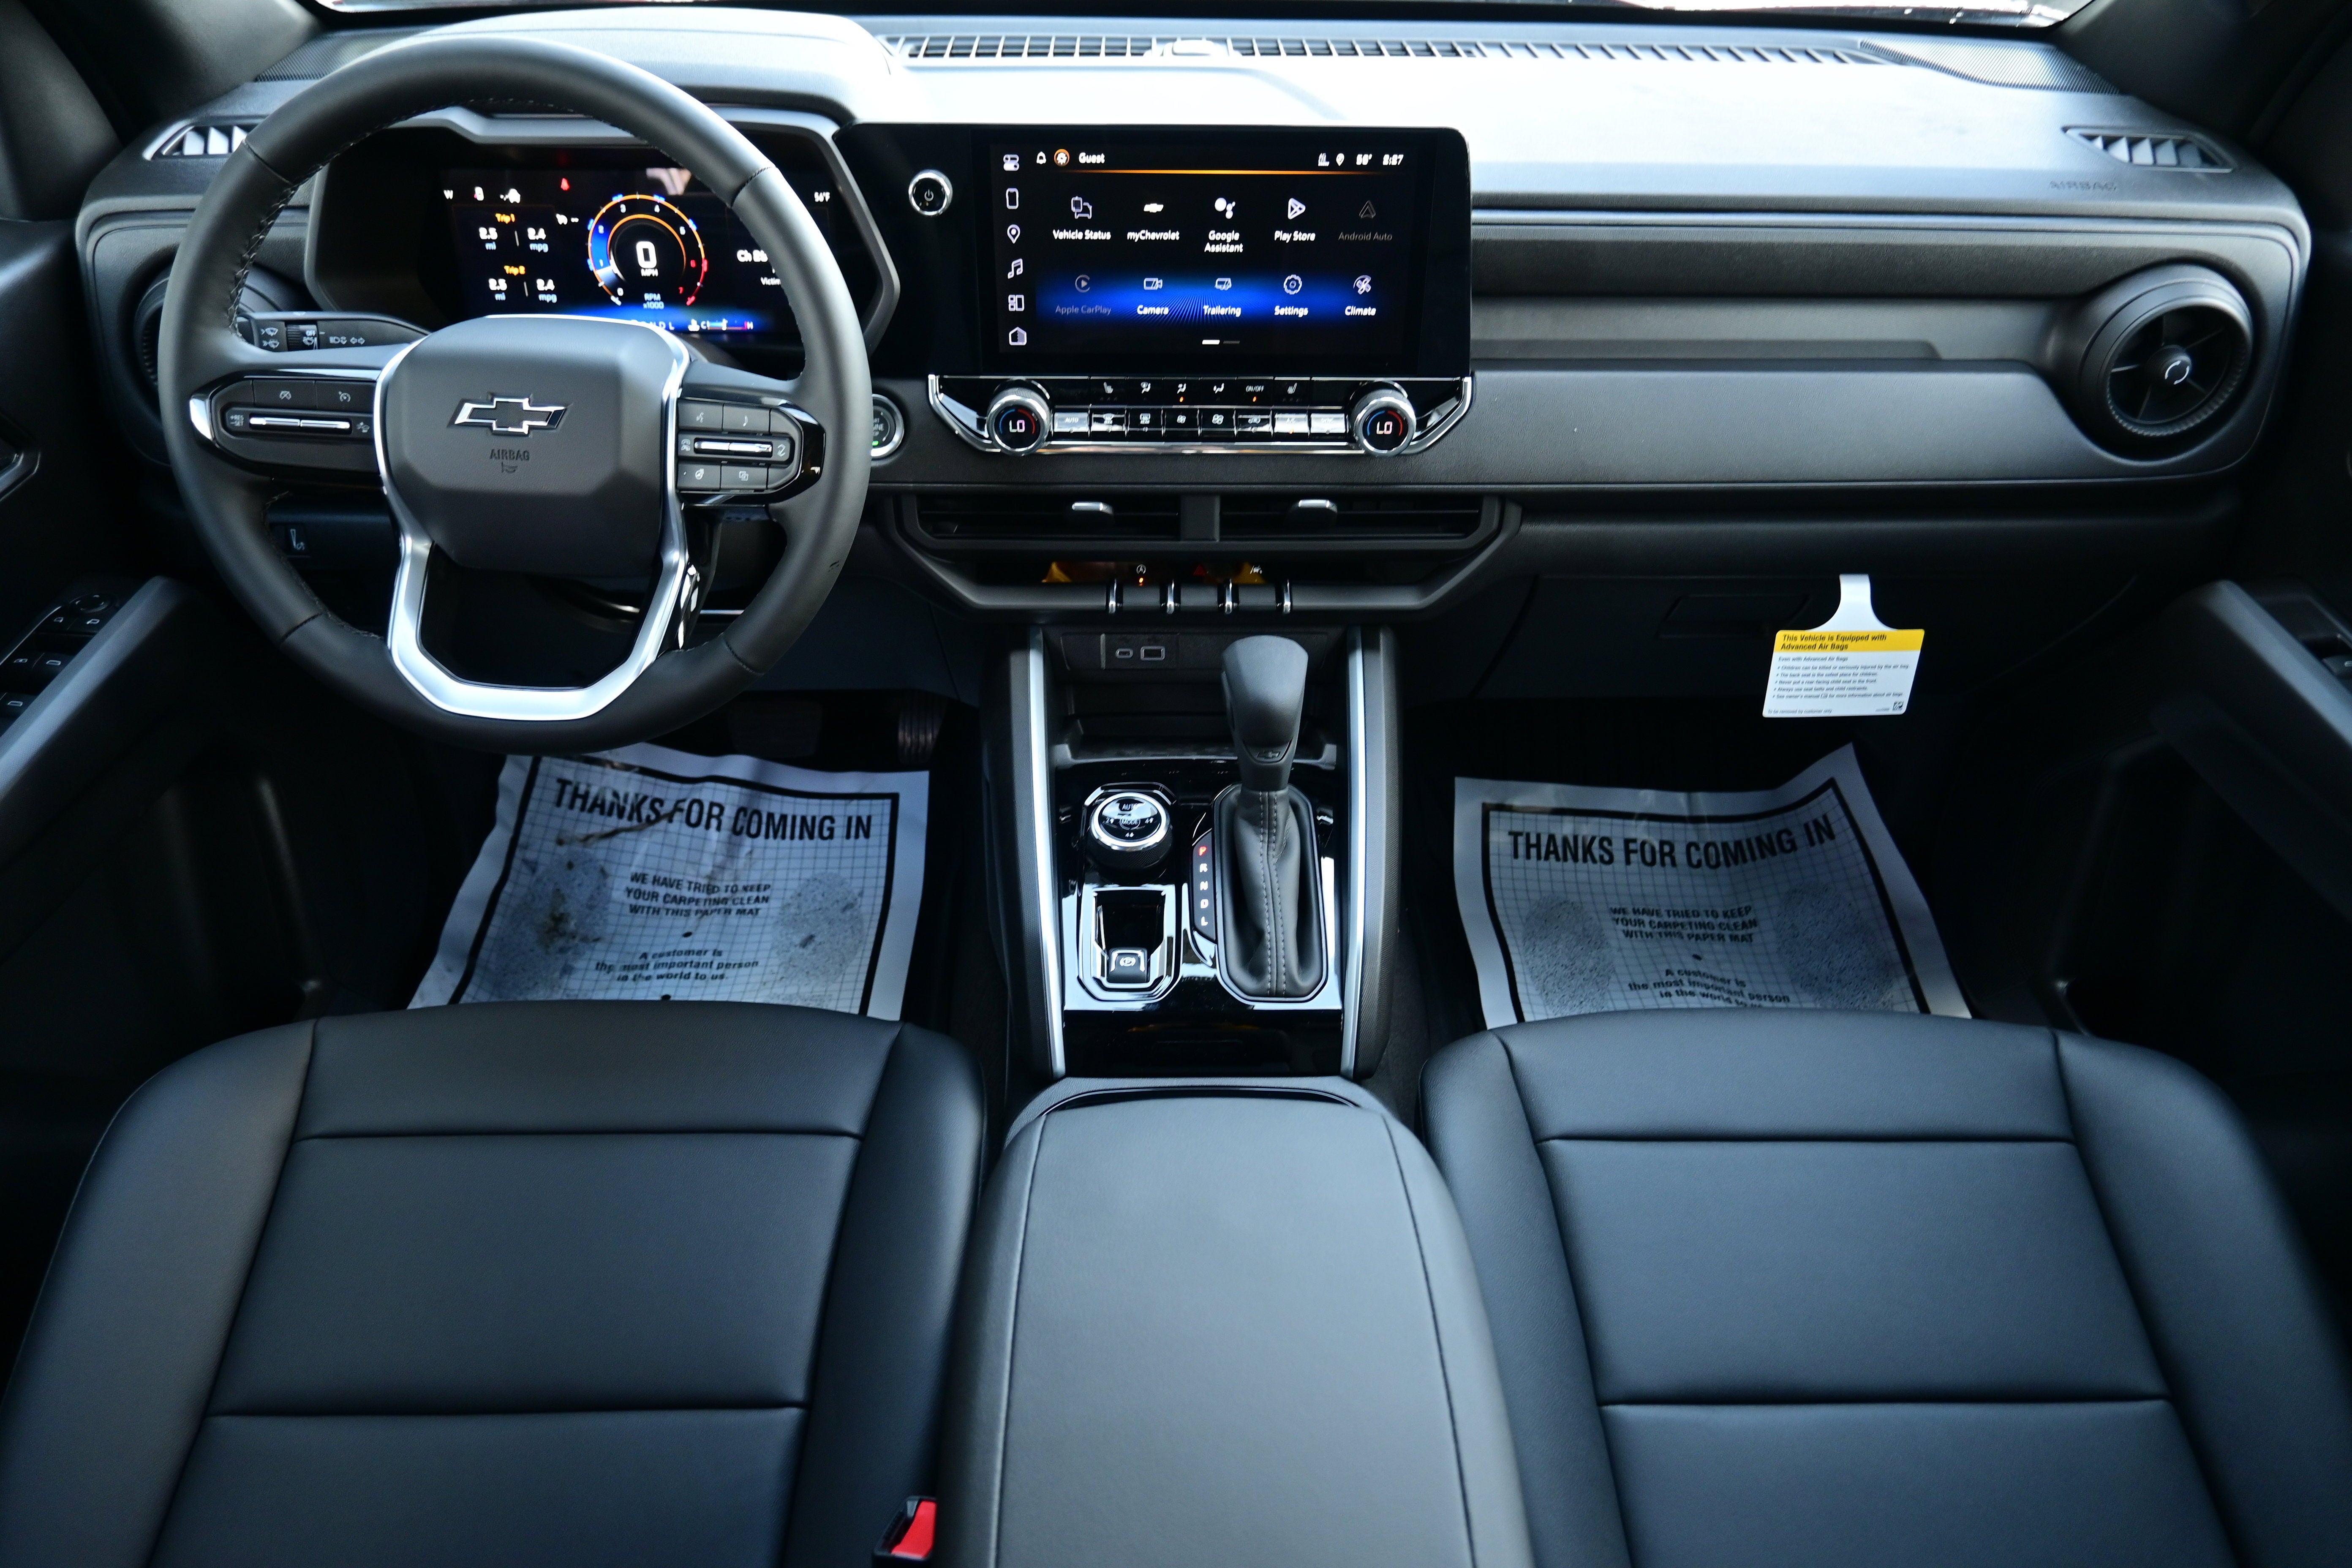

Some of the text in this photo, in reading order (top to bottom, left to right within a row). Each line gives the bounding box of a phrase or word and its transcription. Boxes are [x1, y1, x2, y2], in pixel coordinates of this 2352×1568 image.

[1079, 152, 1105, 163] Guest
[444, 190, 453, 199] W
[495, 213, 511, 224] Trip
[1052, 229, 1111, 240] Vehicle Status
[1127, 229, 1180, 242] myChevrolet
[1209, 230, 1240, 242] Google
[1274, 230, 1315, 243] Play Store
[1338, 231, 1393, 241] Android Auto
[485, 241, 497, 250] mi
[529, 243, 549, 253] mpg
[1204, 242, 1244, 253] Assistant
[636, 241, 658, 269] 0
[737, 250, 752, 262] Ch
[504, 265, 519, 276] Trip
[641, 268, 659, 277] MPH
[495, 292, 506, 301] mi
[538, 294, 557, 303] mpg
[644, 293, 661, 301] RPM
[643, 301, 664, 310] x1000
[1055, 305, 1112, 316] Apple CarPlay
[1137, 305, 1169, 315] Camera
[1203, 305, 1241, 317] Trailering
[1274, 305, 1309, 317] Settings
[1345, 306, 1376, 316] Climate
[1009, 419, 1025, 433] LO
[1376, 421, 1393, 434] LO
[490, 448, 530, 461] AIRBAG
[1836, 634, 1869, 642] Equipped
[1831, 643, 1848, 651] Bags
[556, 779, 872, 841] THANKS FOR COMING IN
[1508, 814, 1836, 870] THANKS FOR COMING IN
[1199, 846, 1207, 856] P
[1199, 863, 1208, 873] R
[630, 872, 772, 895] WE HAVE TRIED TO KEEP
[1200, 881, 1208, 890] N
[626, 887, 770, 906] YOUR CARPETING CLEAN
[1200, 899, 1209, 909] D
[629, 904, 661, 916] WITH
[664, 908, 692, 917] THIS
[735, 907, 762, 916] MAT
[1610, 905, 1753, 919] WE HAVE TRIED TO KEEP
[1201, 916, 1209, 926] L
[1612, 917, 1758, 931] YOUR CARPETING CLEAN
[1622, 929, 1754, 943] WITH THIS PAPER MAT
[638, 948, 723, 961] A customer is
[620, 961, 650, 972] most
[653, 960, 714, 972] important
[716, 960, 760, 972] person
[656, 971, 691, 980] world
[694, 971, 708, 981] to
[1665, 968, 1746, 988] A customer is
[1628, 978, 1790, 1003] the most important person
[1674, 989, 1696, 998] the
